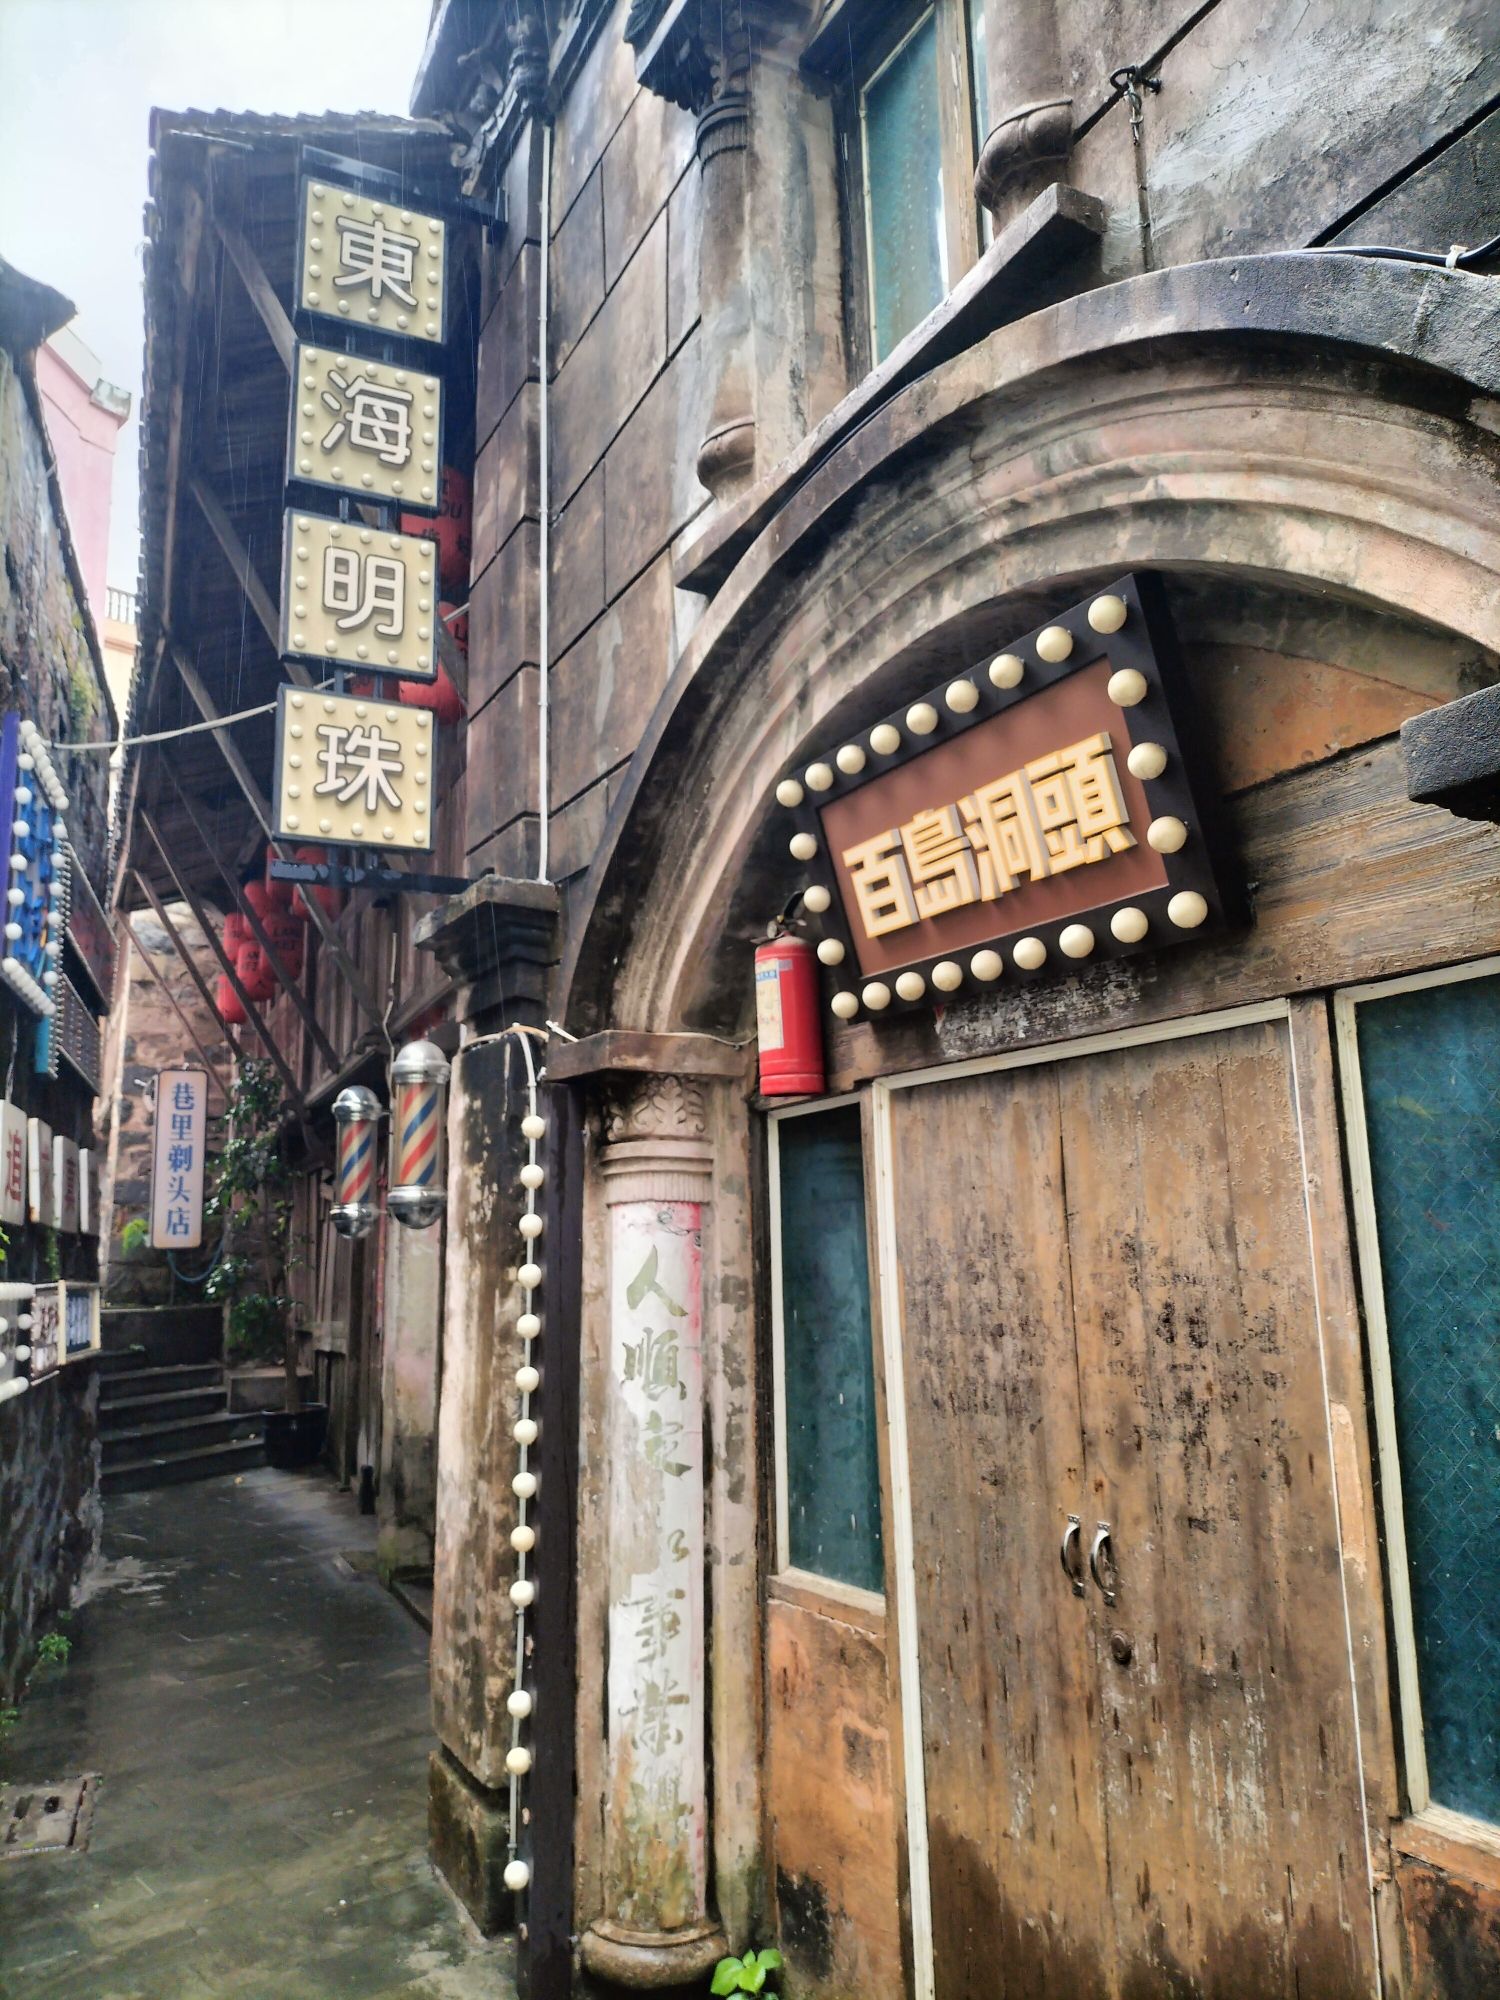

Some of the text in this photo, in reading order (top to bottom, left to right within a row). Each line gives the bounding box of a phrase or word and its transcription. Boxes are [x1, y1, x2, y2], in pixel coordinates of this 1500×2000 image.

[313, 218, 420, 811] 東海明珠
[842, 732, 1138, 938] 百島洞頭
[166, 1082, 195, 1237] 巷里剃头店
